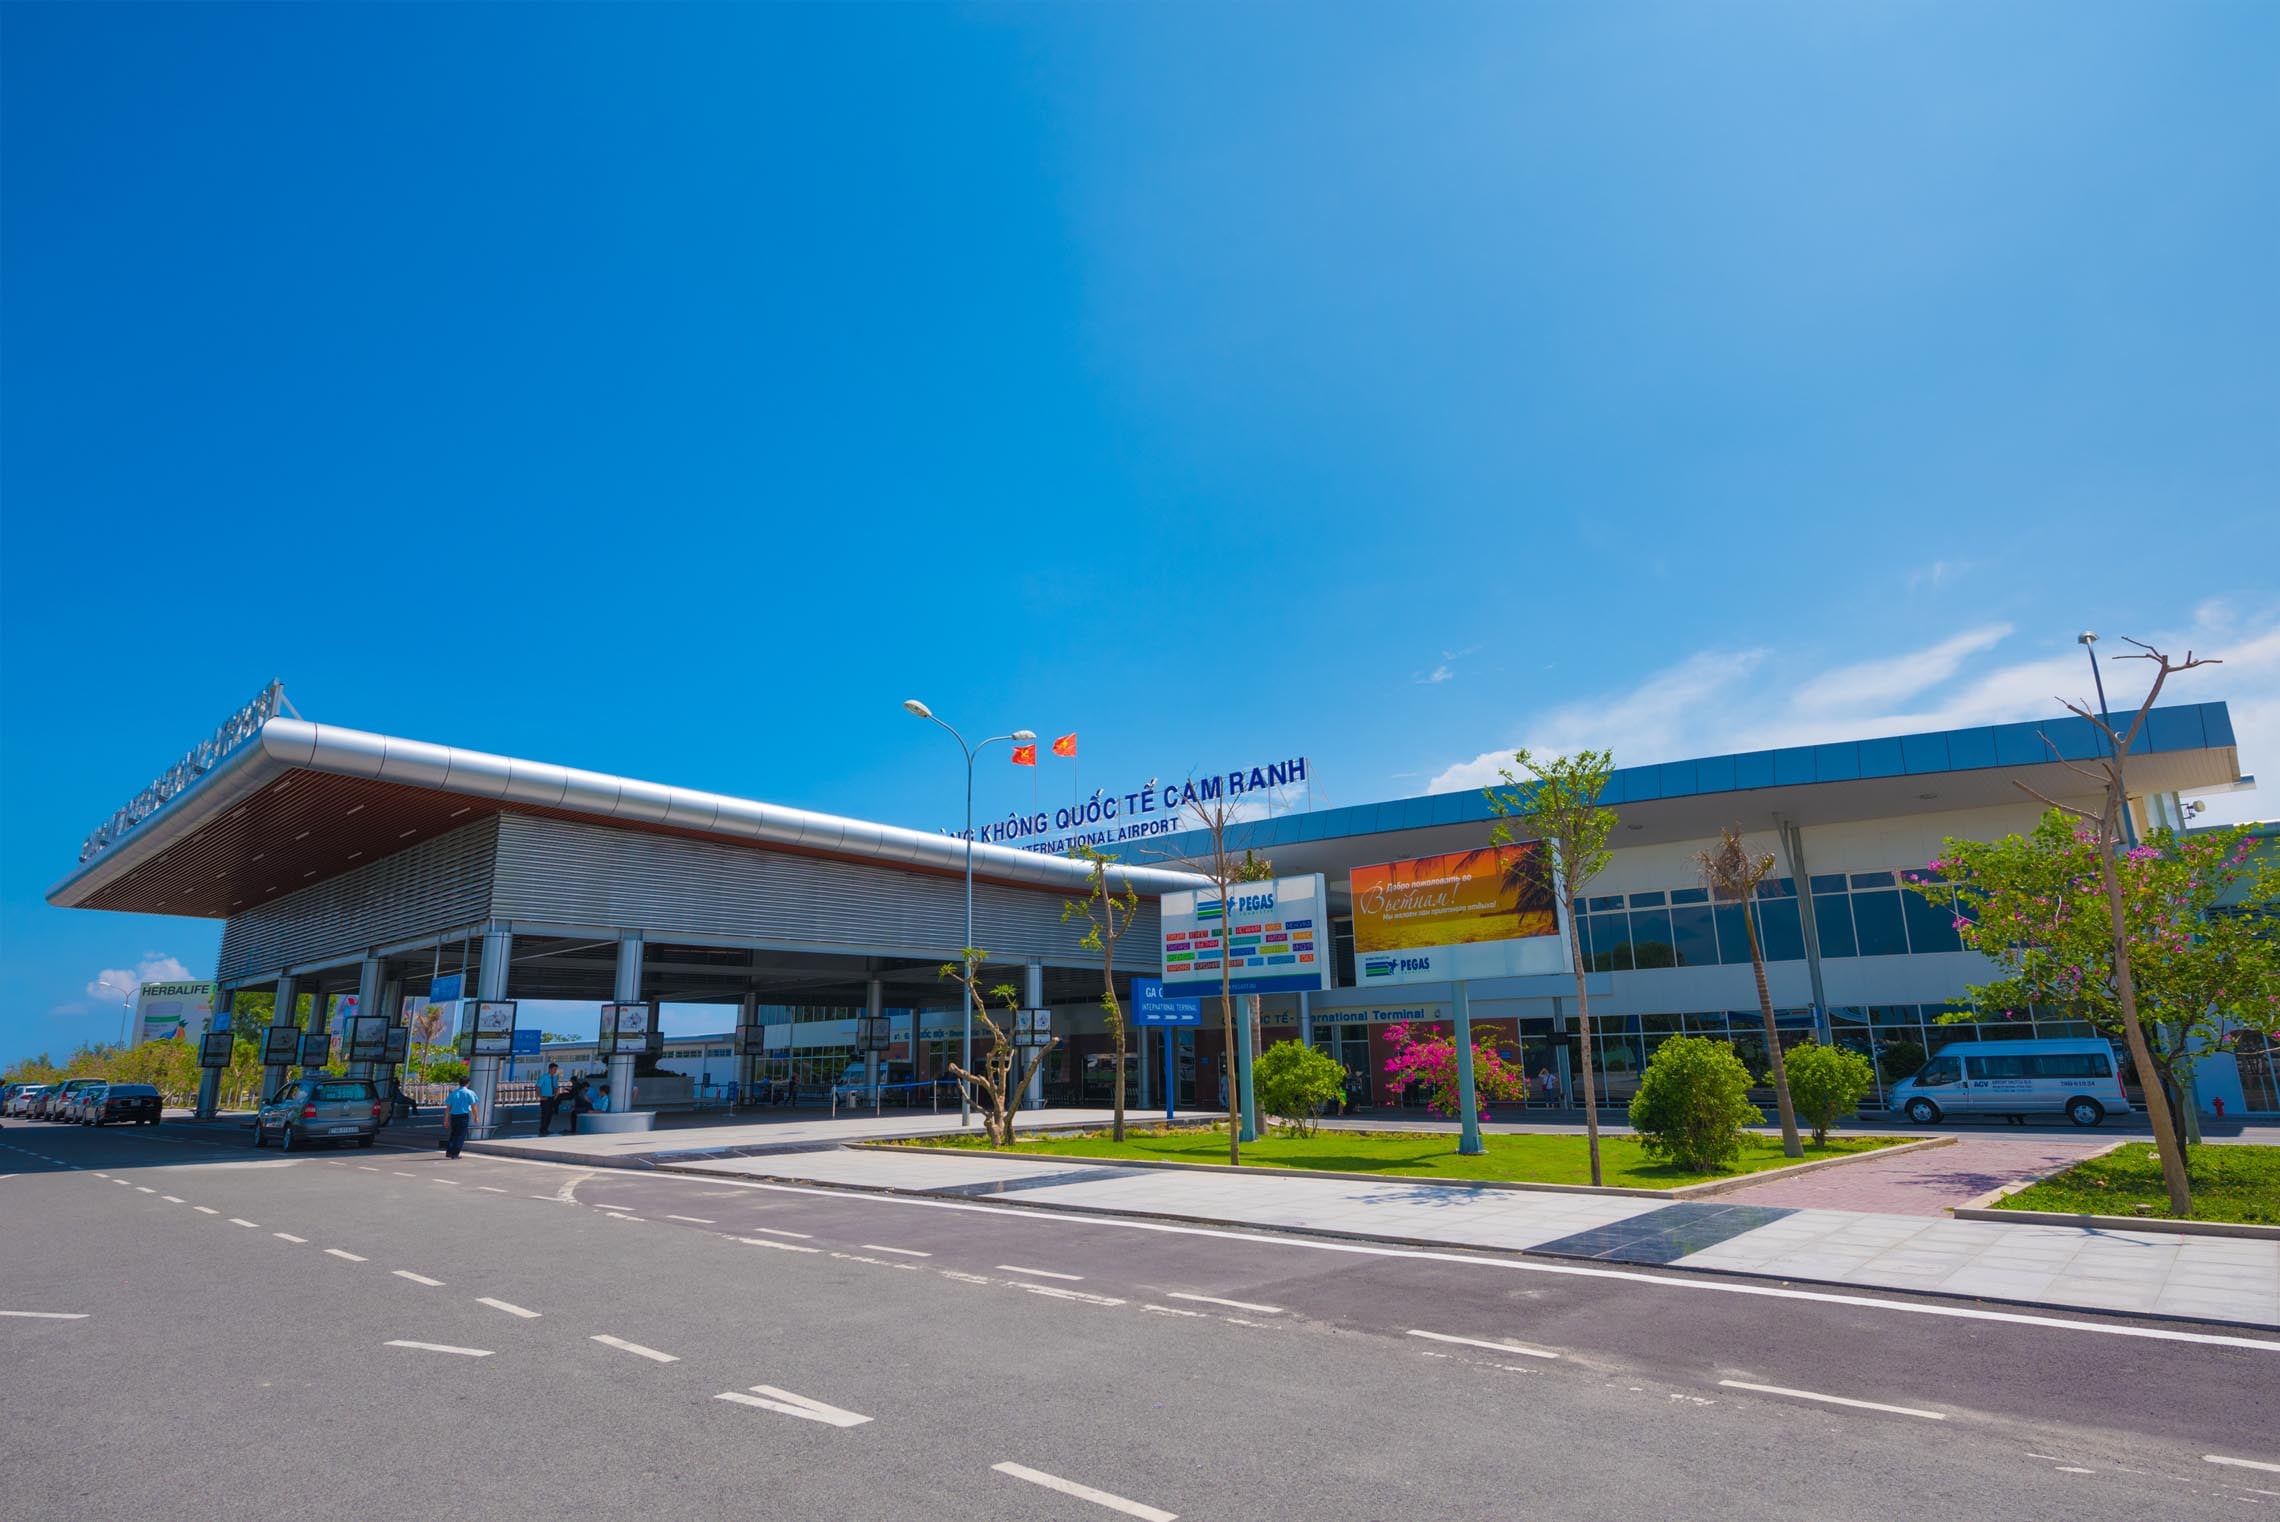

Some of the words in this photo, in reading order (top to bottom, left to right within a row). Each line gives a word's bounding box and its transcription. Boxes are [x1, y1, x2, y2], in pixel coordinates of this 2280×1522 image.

[981, 812, 1048, 843] KHÔNG
[1055, 788, 1117, 829] QUỐC
[1125, 778, 1155, 815] TẾ
[1164, 776, 1221, 808] CAM
[1229, 757, 1306, 795] RANH
[1017, 832, 1114, 855] TERNATIONAL
[1118, 817, 1180, 841] AIRPORT
[1239, 893, 1274, 912] PEGAS
[1400, 957, 1430, 971] PEGAS
[142, 985, 210, 997] HERBALIFE
[1145, 987, 1157, 998] GA
[1373, 1008, 1425, 1021] Terminal
